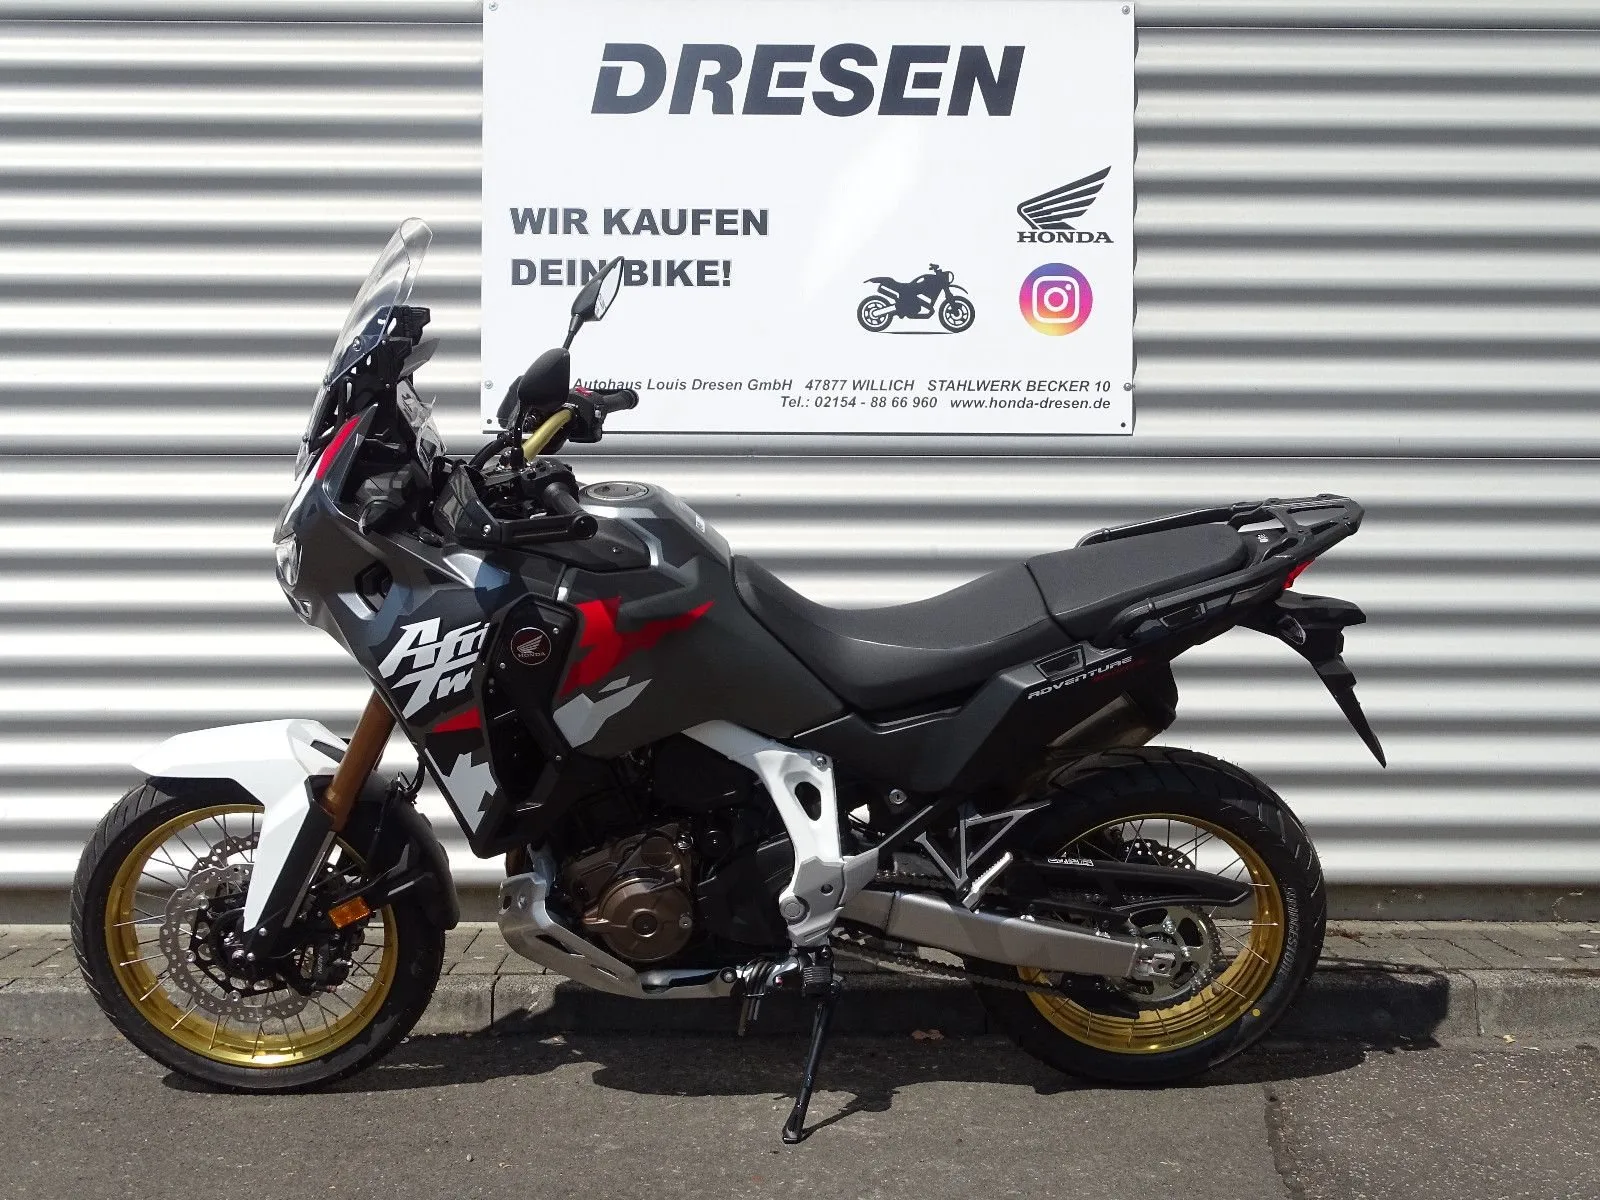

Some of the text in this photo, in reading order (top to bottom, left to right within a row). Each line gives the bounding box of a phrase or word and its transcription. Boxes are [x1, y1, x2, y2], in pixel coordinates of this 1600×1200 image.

[591, 43, 1025, 117] DRESEN
[510, 207, 768, 236] WIR KAUFEN
[1016, 231, 1114, 244] HONDA
[622, 259, 731, 287] BIKE!
[573, 378, 1111, 393] Autohaus Louis Dresen GmbH 47877 WILLICH STAHLWERK BECKER 10
[780, 396, 810, 408] Tel.:
[814, 396, 857, 408] 02154
[870, 396, 887, 408] 88
[891, 396, 908, 408] 66
[912, 396, 938, 408] 960
[950, 397, 1111, 409] www.honda-dresen.de
[378, 617, 490, 679] Afri
[1027, 655, 1132, 699] ADVENTURE
